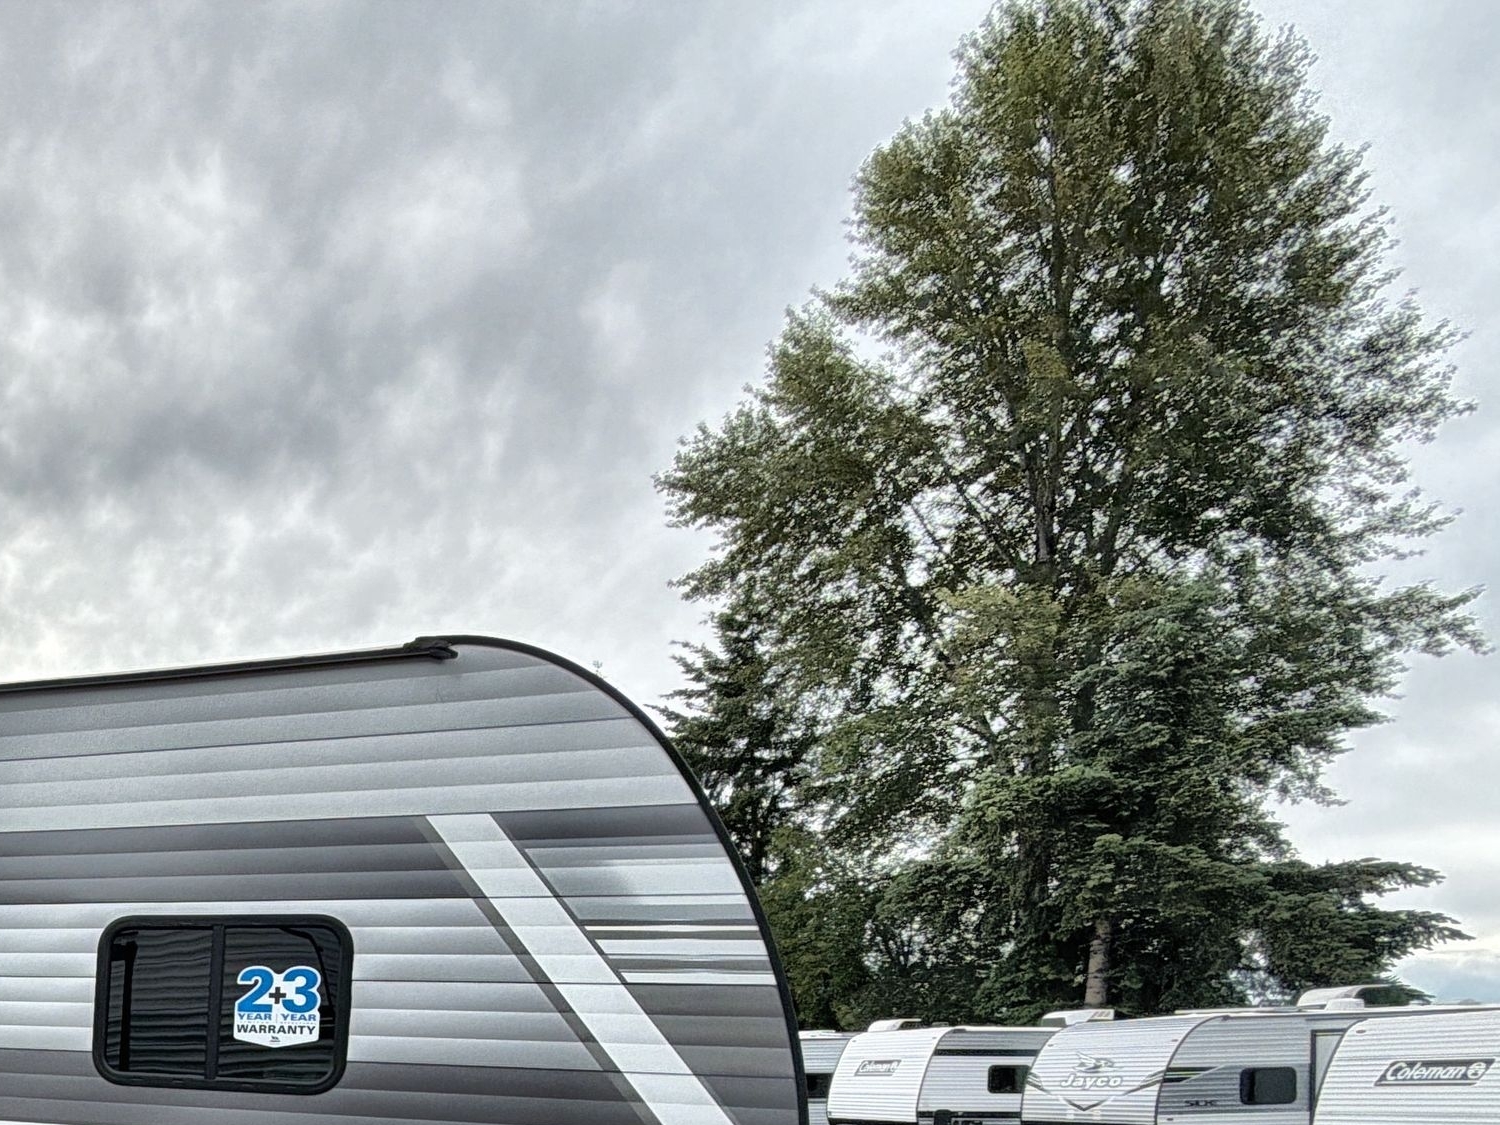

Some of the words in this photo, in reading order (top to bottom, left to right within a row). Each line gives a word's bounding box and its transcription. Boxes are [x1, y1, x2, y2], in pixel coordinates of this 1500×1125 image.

[238, 1013, 272, 1021] YEAR
[280, 1013, 317, 1021] YEAR
[236, 1024, 316, 1035] WARRANTY
[1386, 1062, 1467, 1080] Coleman
[1060, 1072, 1123, 1090] Jayco
